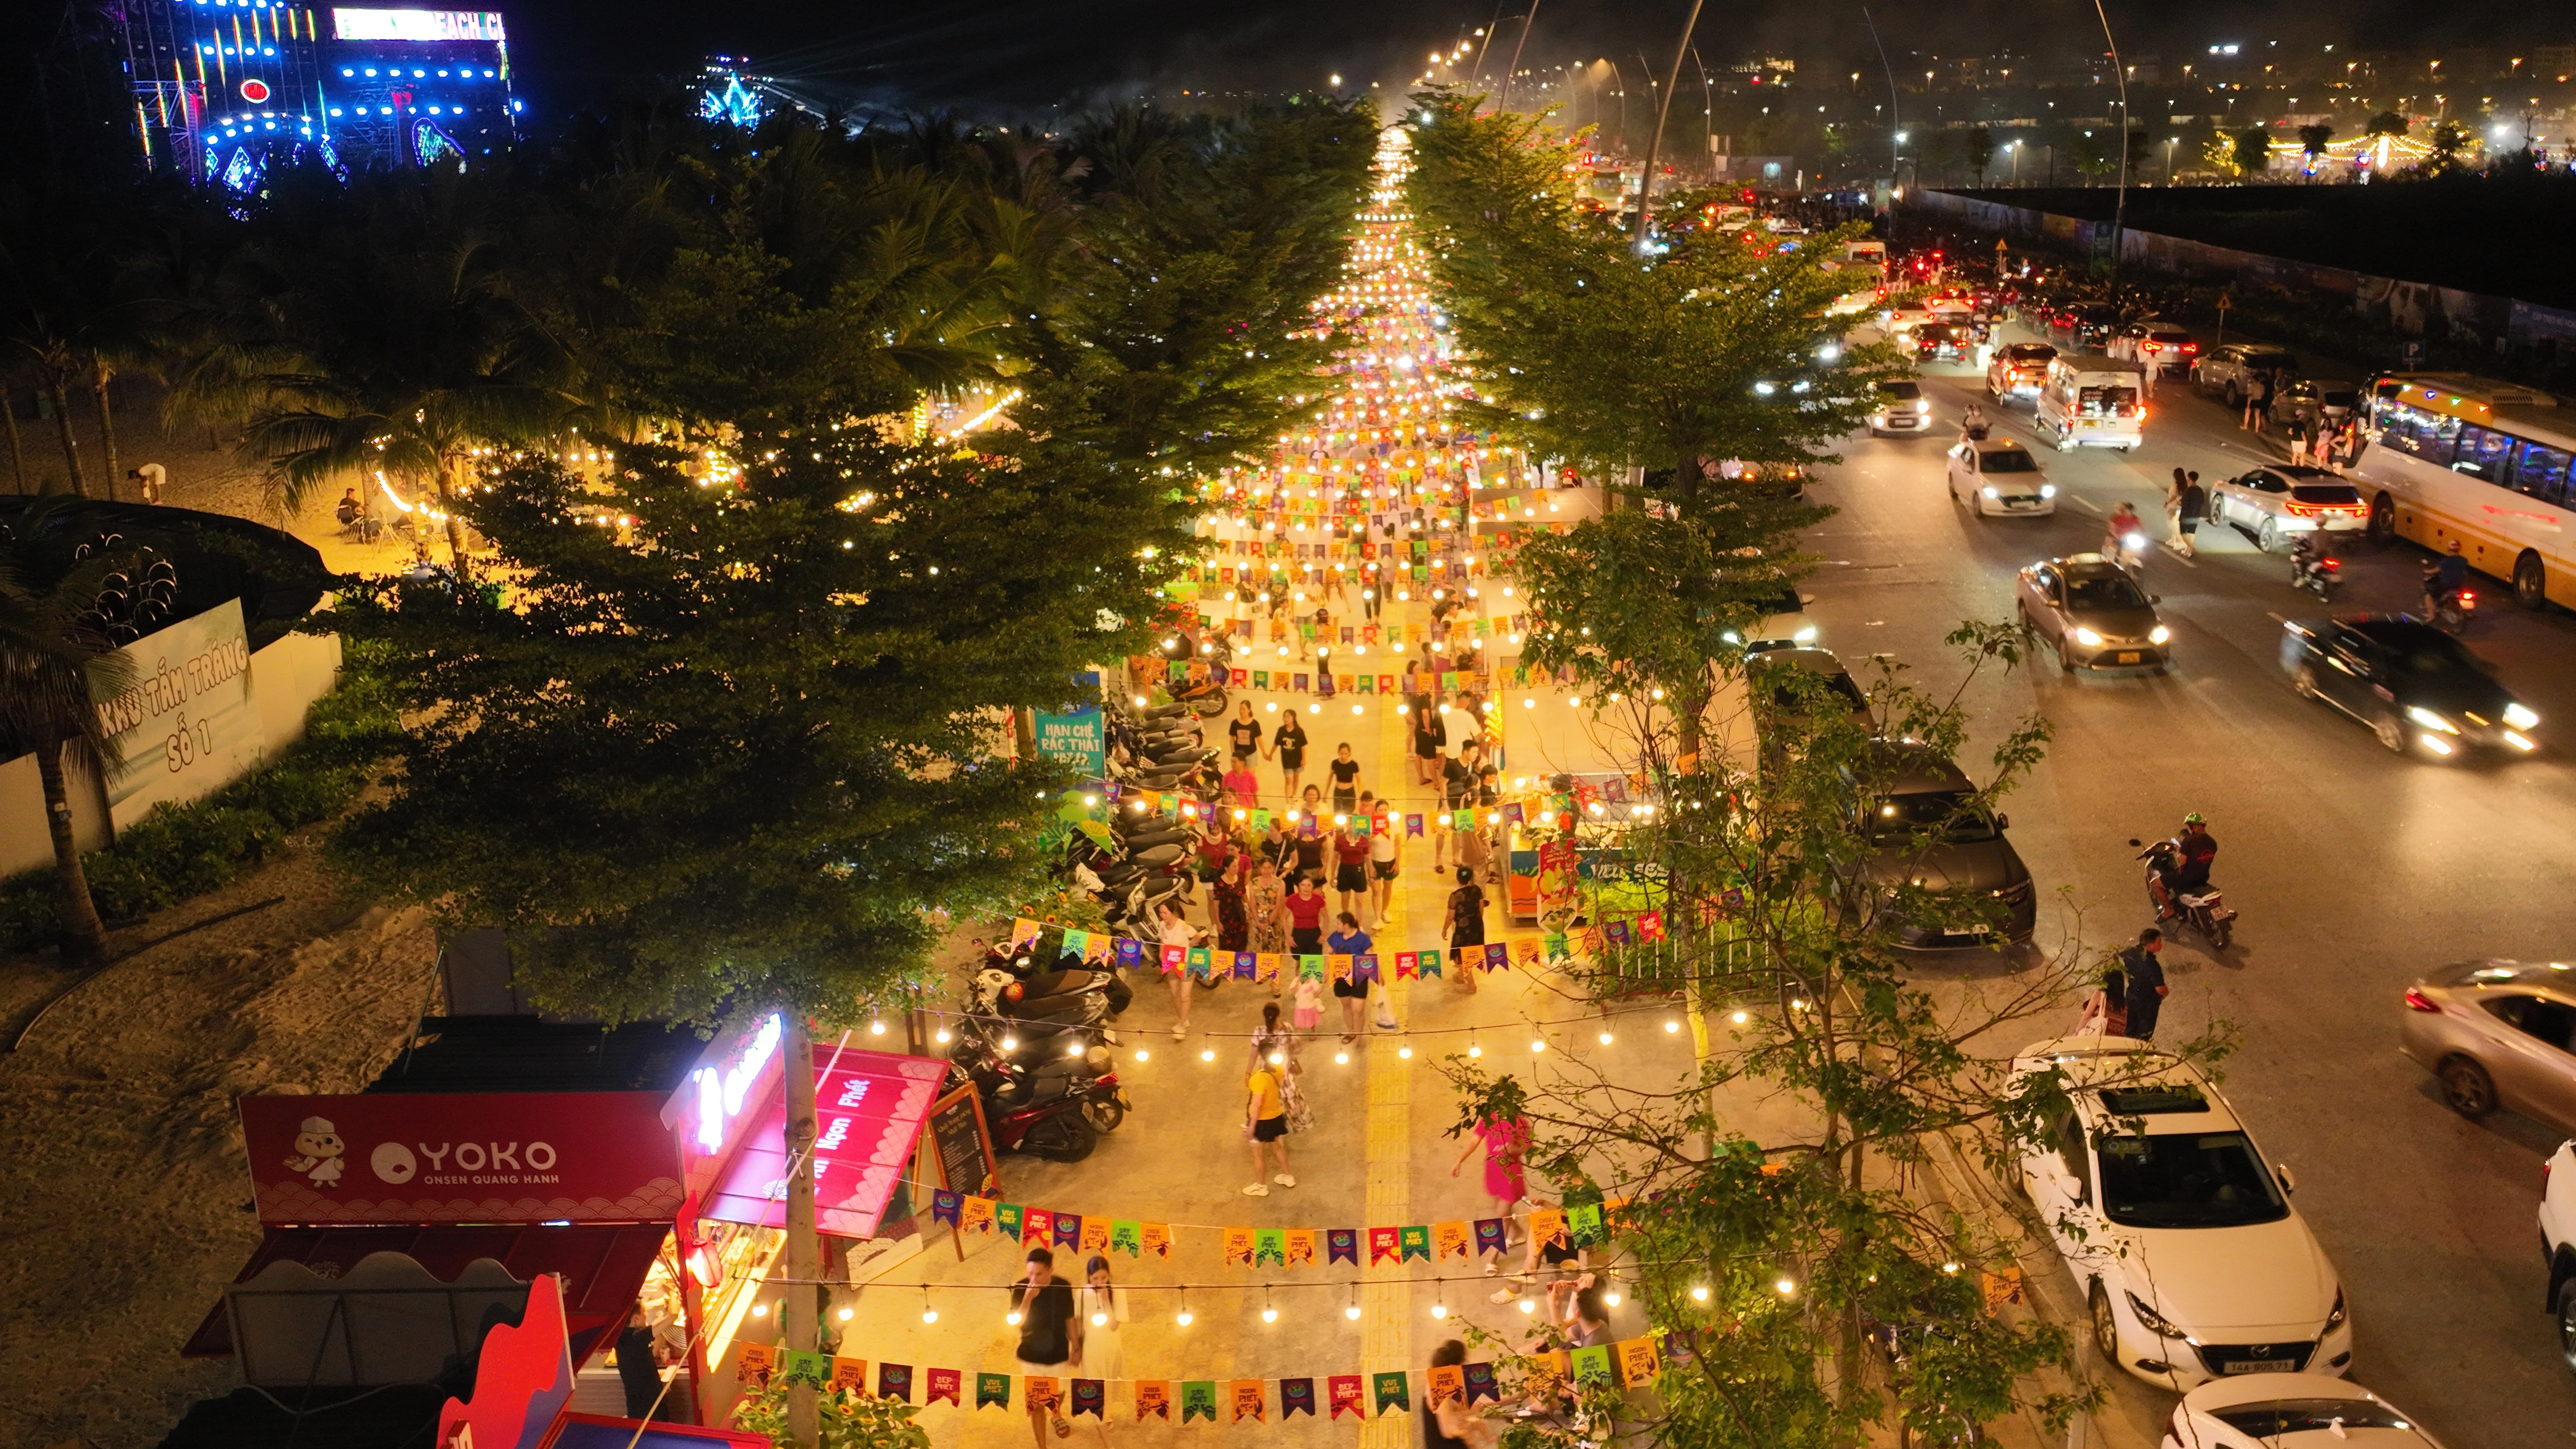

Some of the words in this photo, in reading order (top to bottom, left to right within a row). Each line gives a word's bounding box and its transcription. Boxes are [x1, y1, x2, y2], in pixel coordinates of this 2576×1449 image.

[2409, 343, 2419, 356] P
[166, 712, 194, 772] SỐ
[198, 719, 211, 755] 1
[815, 1117, 852, 1150] Ngon
[418, 1141, 557, 1171] YOKO
[424, 1175, 468, 1185] ONSEN
[472, 1175, 519, 1185] QUANG
[523, 1174, 560, 1184] HANH
